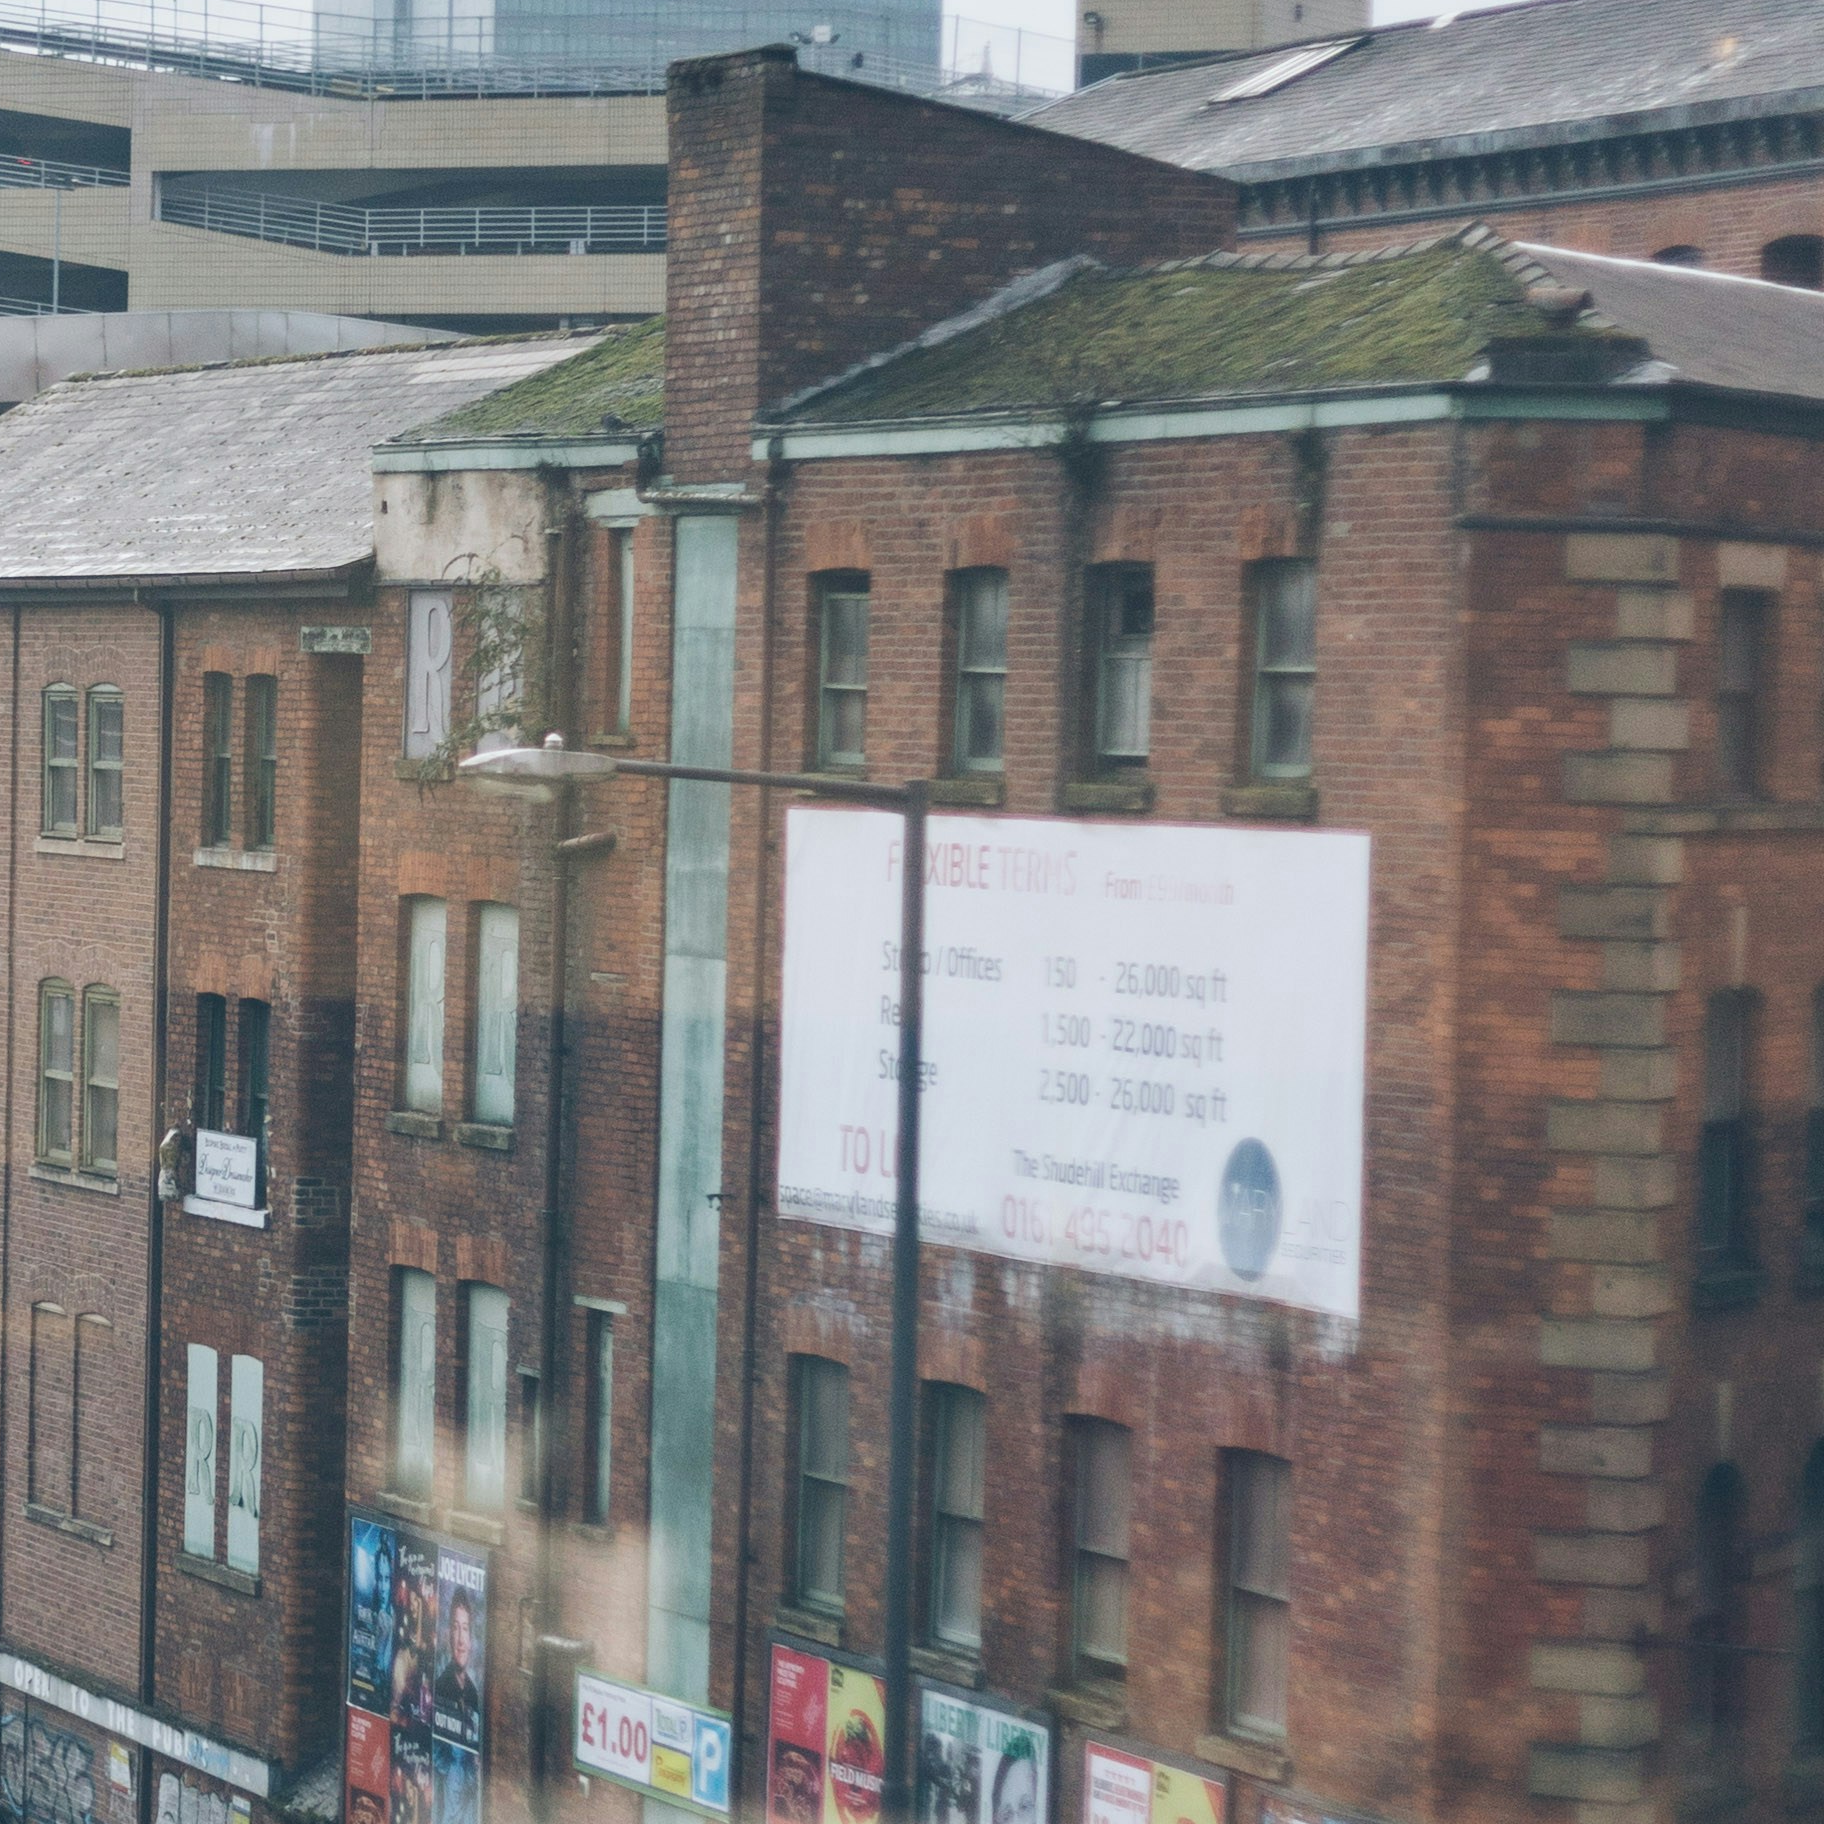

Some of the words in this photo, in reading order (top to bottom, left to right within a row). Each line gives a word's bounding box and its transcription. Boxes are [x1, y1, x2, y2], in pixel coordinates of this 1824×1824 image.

[998, 847, 1078, 897] TERMS
[1104, 870, 1142, 903] From
[946, 946, 1003, 983] Offices
[1043, 957, 1077, 989] 150
[1115, 961, 1181, 999] 26,000
[1186, 973, 1206, 1008] sq
[1210, 970, 1228, 1004] ft
[1041, 1012, 1092, 1049] 1,500
[1112, 1017, 1177, 1059] 22,000
[1181, 1032, 1201, 1066] sq
[1207, 1030, 1225, 1063] ft
[1039, 1069, 1090, 1106] 2,500
[1110, 1078, 1176, 1116] 26,000
[1185, 1090, 1206, 1124] sq
[1210, 1087, 1228, 1123] ft
[840, 1125, 870, 1173] TO
[1012, 1149, 1039, 1178] The
[1041, 1152, 1104, 1192] Shudehill
[1108, 1163, 1181, 1200] Exchange
[1001, 1193, 1056, 1244] 0161
[1065, 1206, 1111, 1256] 495
[1122, 1213, 1190, 1268] 2040
[438, 1555, 456, 1583] JOE
[457, 1562, 486, 1592] LYCETT
[14, 1659, 51, 1698] OPEN
[70, 1684, 90, 1716] TO
[107, 1700, 145, 1736] THE
[582, 1701, 649, 1765] £1.00
[699, 1727, 722, 1793] P
[829, 1762, 854, 1787] FIELD
[855, 1768, 885, 1794] MUSIC
